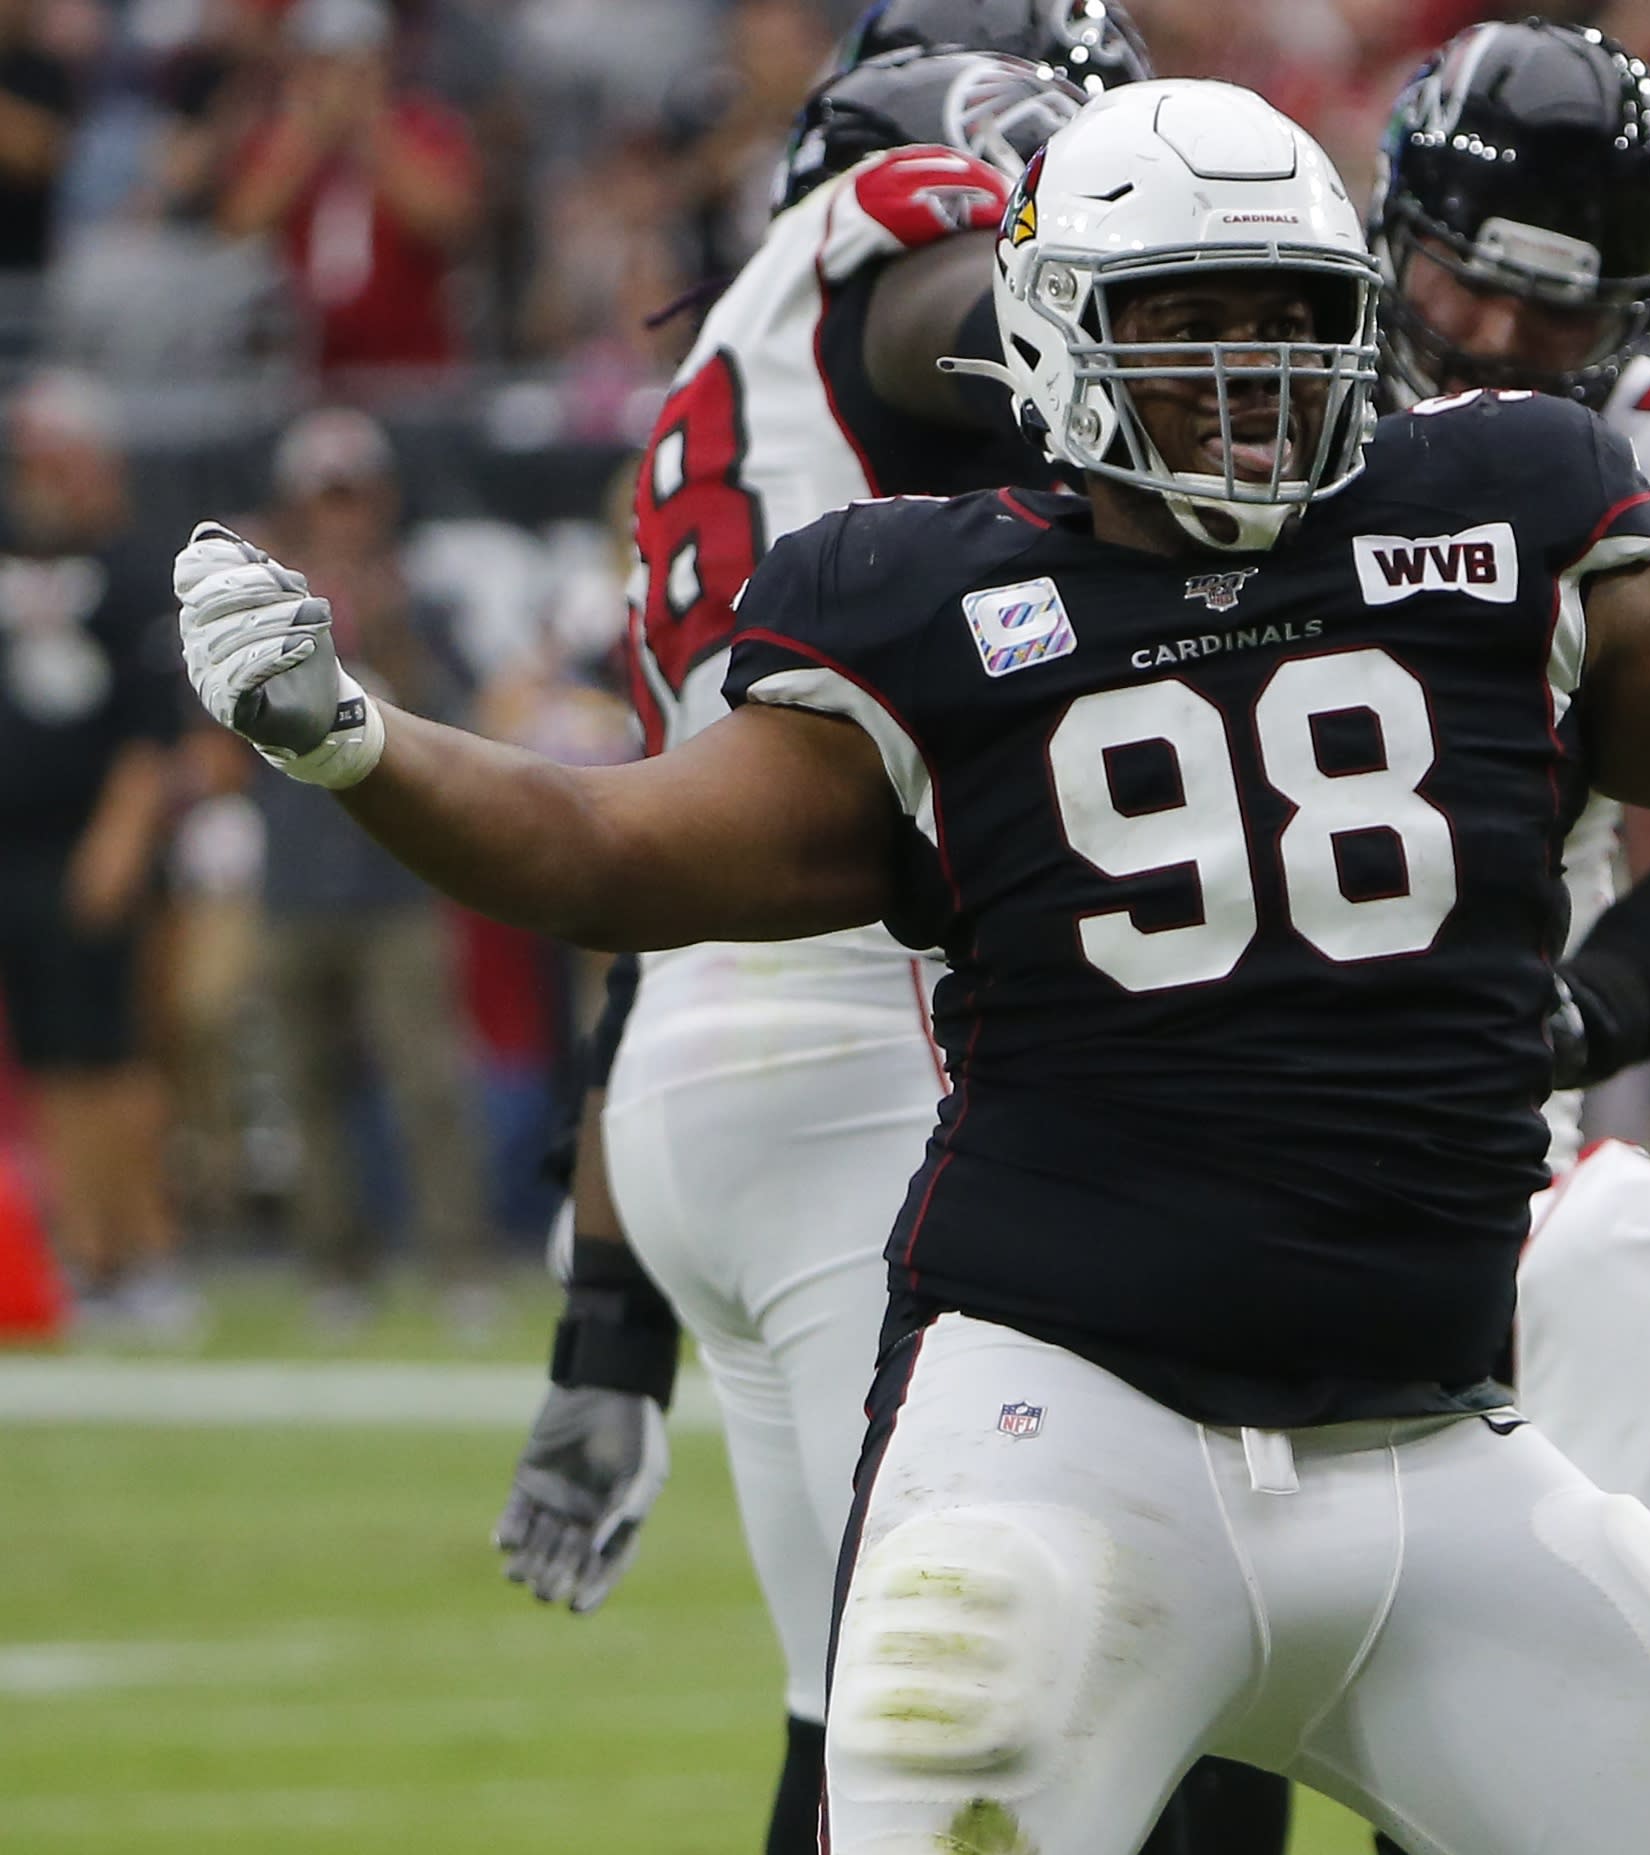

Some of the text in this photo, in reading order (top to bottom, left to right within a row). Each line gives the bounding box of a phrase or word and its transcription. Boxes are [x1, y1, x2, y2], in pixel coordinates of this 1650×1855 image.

[1222, 213, 1299, 224] CARDINALS
[1372, 541, 1498, 587] WVB
[1130, 619, 1324, 670] CARDINALS
[1048, 647, 1459, 993] 98
